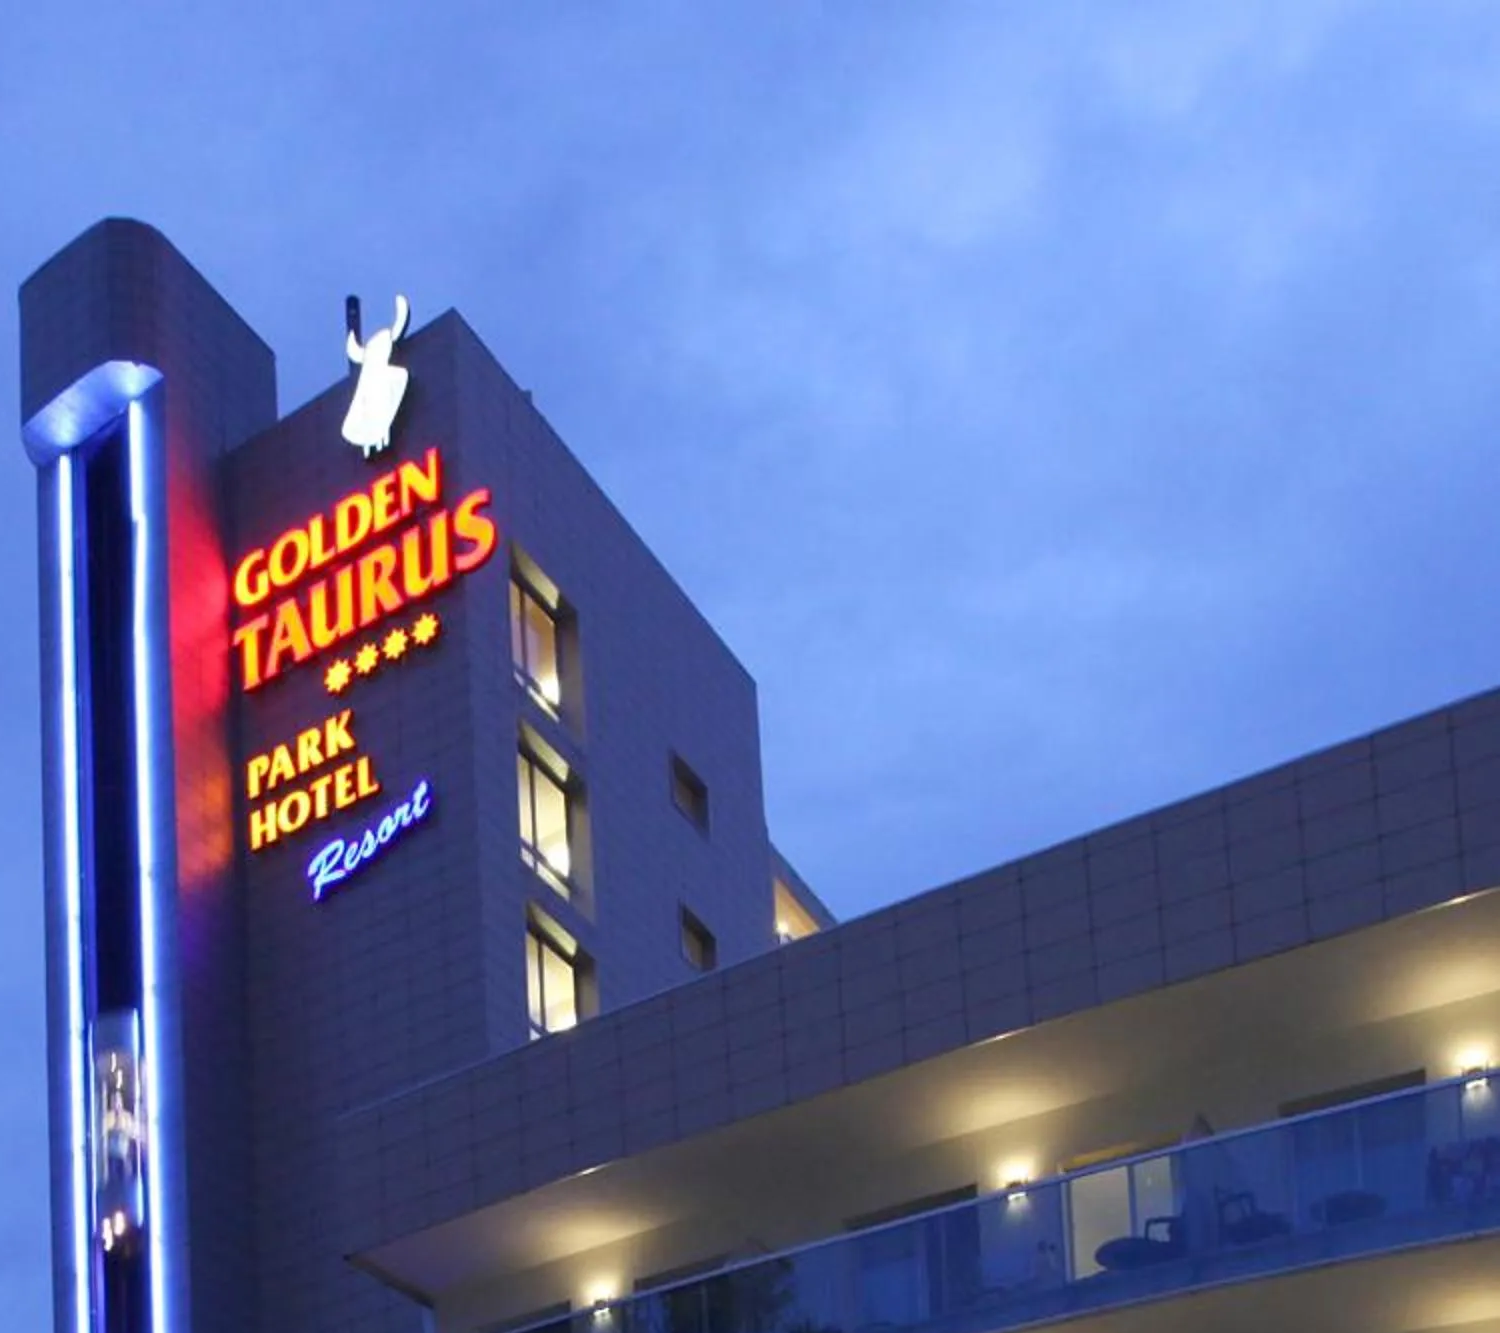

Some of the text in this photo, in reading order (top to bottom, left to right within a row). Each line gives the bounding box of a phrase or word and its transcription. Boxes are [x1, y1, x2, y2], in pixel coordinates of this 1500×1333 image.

[234, 448, 441, 608] GOLDEN
[233, 490, 496, 692] TAURUS
[247, 709, 355, 800] PARK
[250, 757, 380, 852] HOTEL
[307, 780, 431, 900] Resort
